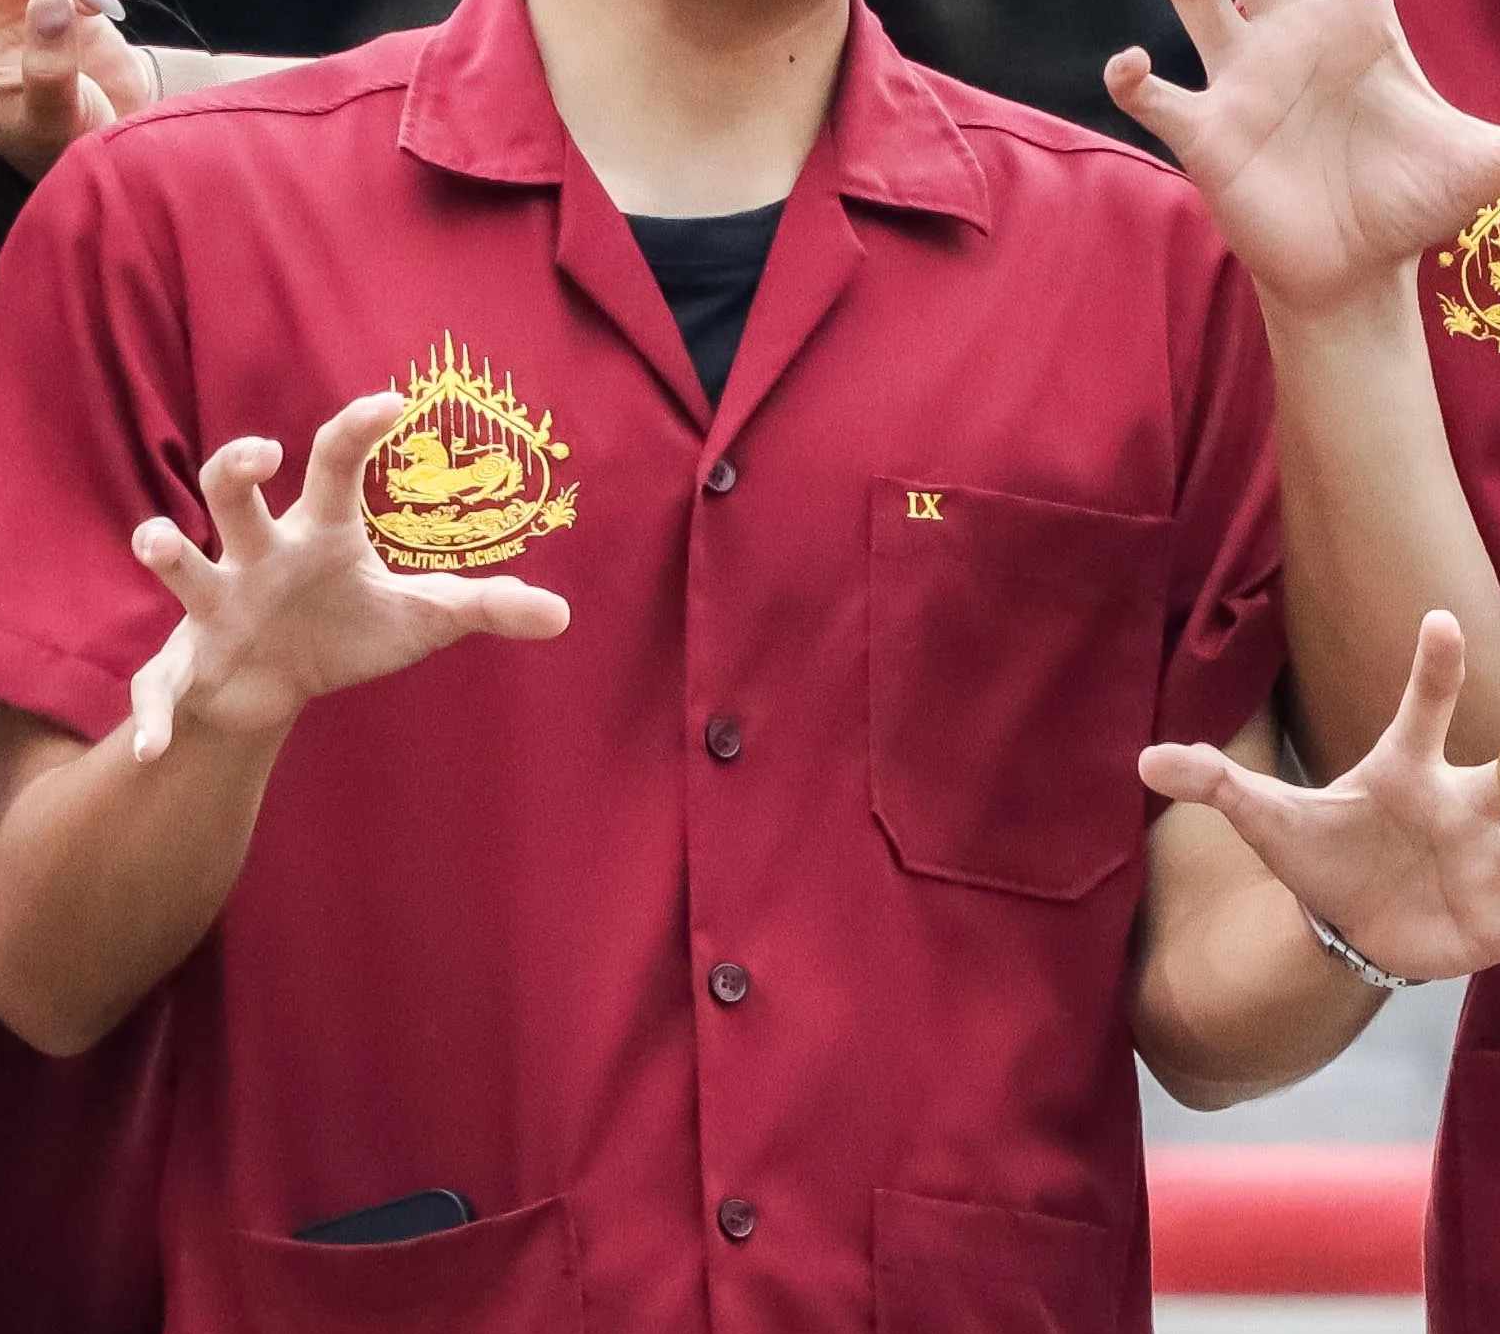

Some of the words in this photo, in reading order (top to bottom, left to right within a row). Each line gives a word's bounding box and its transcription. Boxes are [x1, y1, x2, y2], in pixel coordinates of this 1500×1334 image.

[906, 491, 944, 521] IX
[386, 547, 462, 570] POLITICAL
[464, 539, 527, 568] SCIENCE
